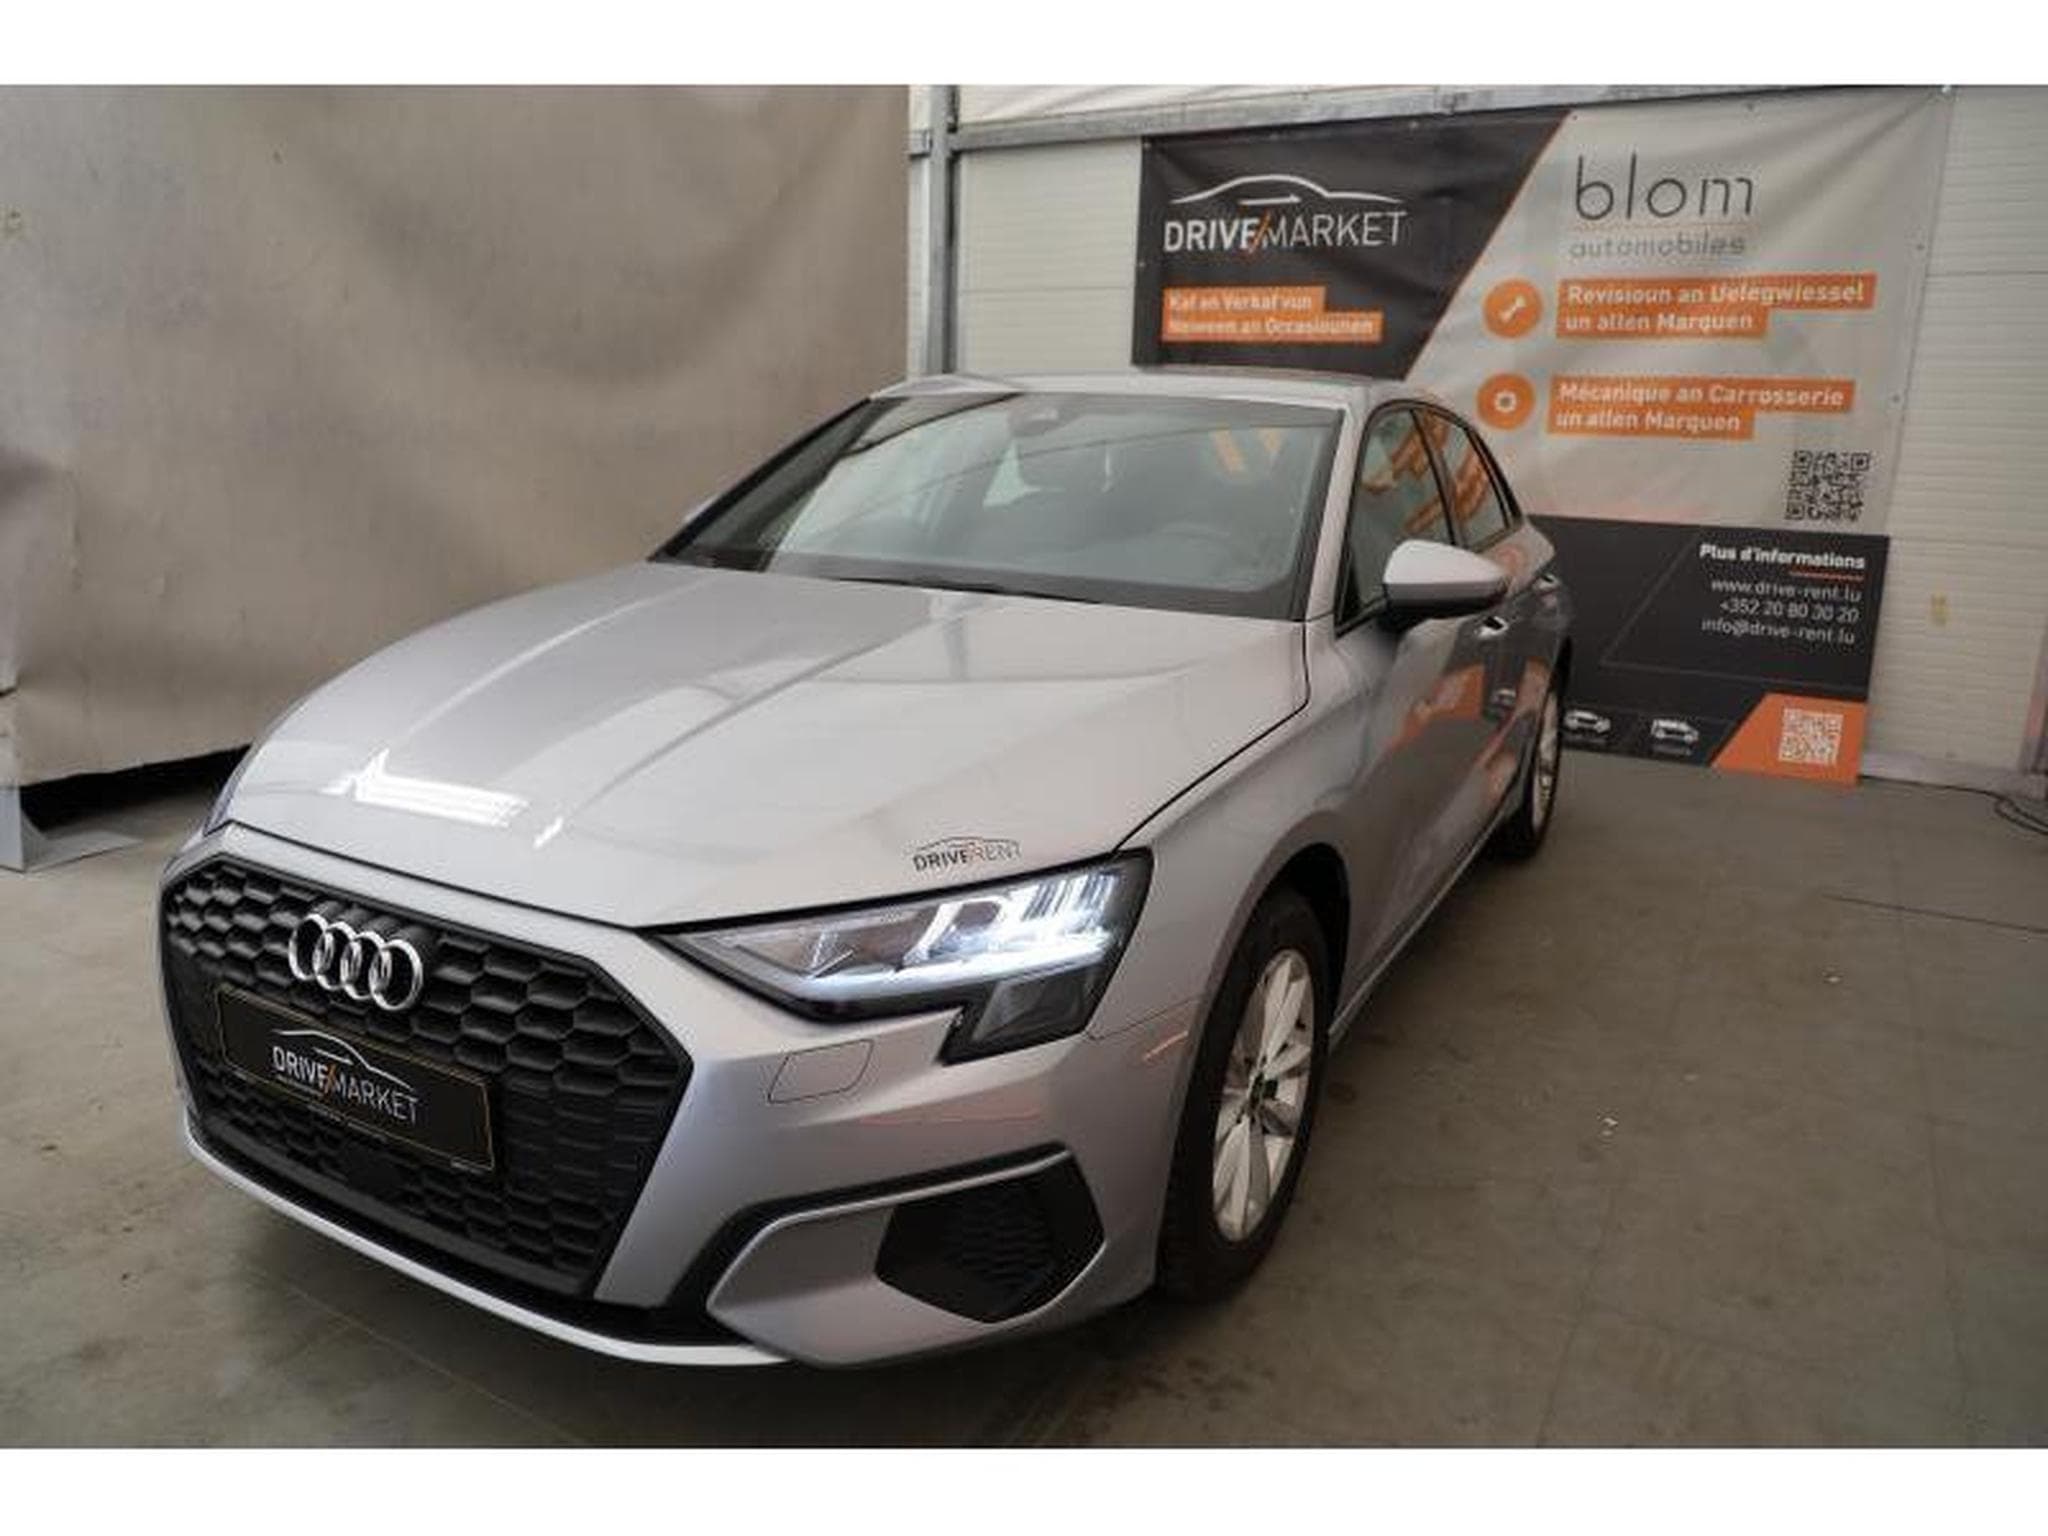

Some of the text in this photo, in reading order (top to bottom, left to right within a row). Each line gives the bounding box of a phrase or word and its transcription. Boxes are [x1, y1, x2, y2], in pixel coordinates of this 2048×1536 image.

[1575, 152, 1754, 221] blom
[1570, 232, 1747, 260] automobiles
[1678, 288, 1704, 303] an
[1565, 314, 1591, 330] un
[1596, 310, 1650, 330] allen
[1558, 381, 1845, 406] Mécanique an Carrosserie
[1555, 411, 1582, 427] un
[1586, 408, 1639, 429] allen
[1699, 543, 1865, 570] Plus d'informations
[1711, 579, 1862, 603] www.drive-rent.lu
[1719, 597, 1760, 615] +352
